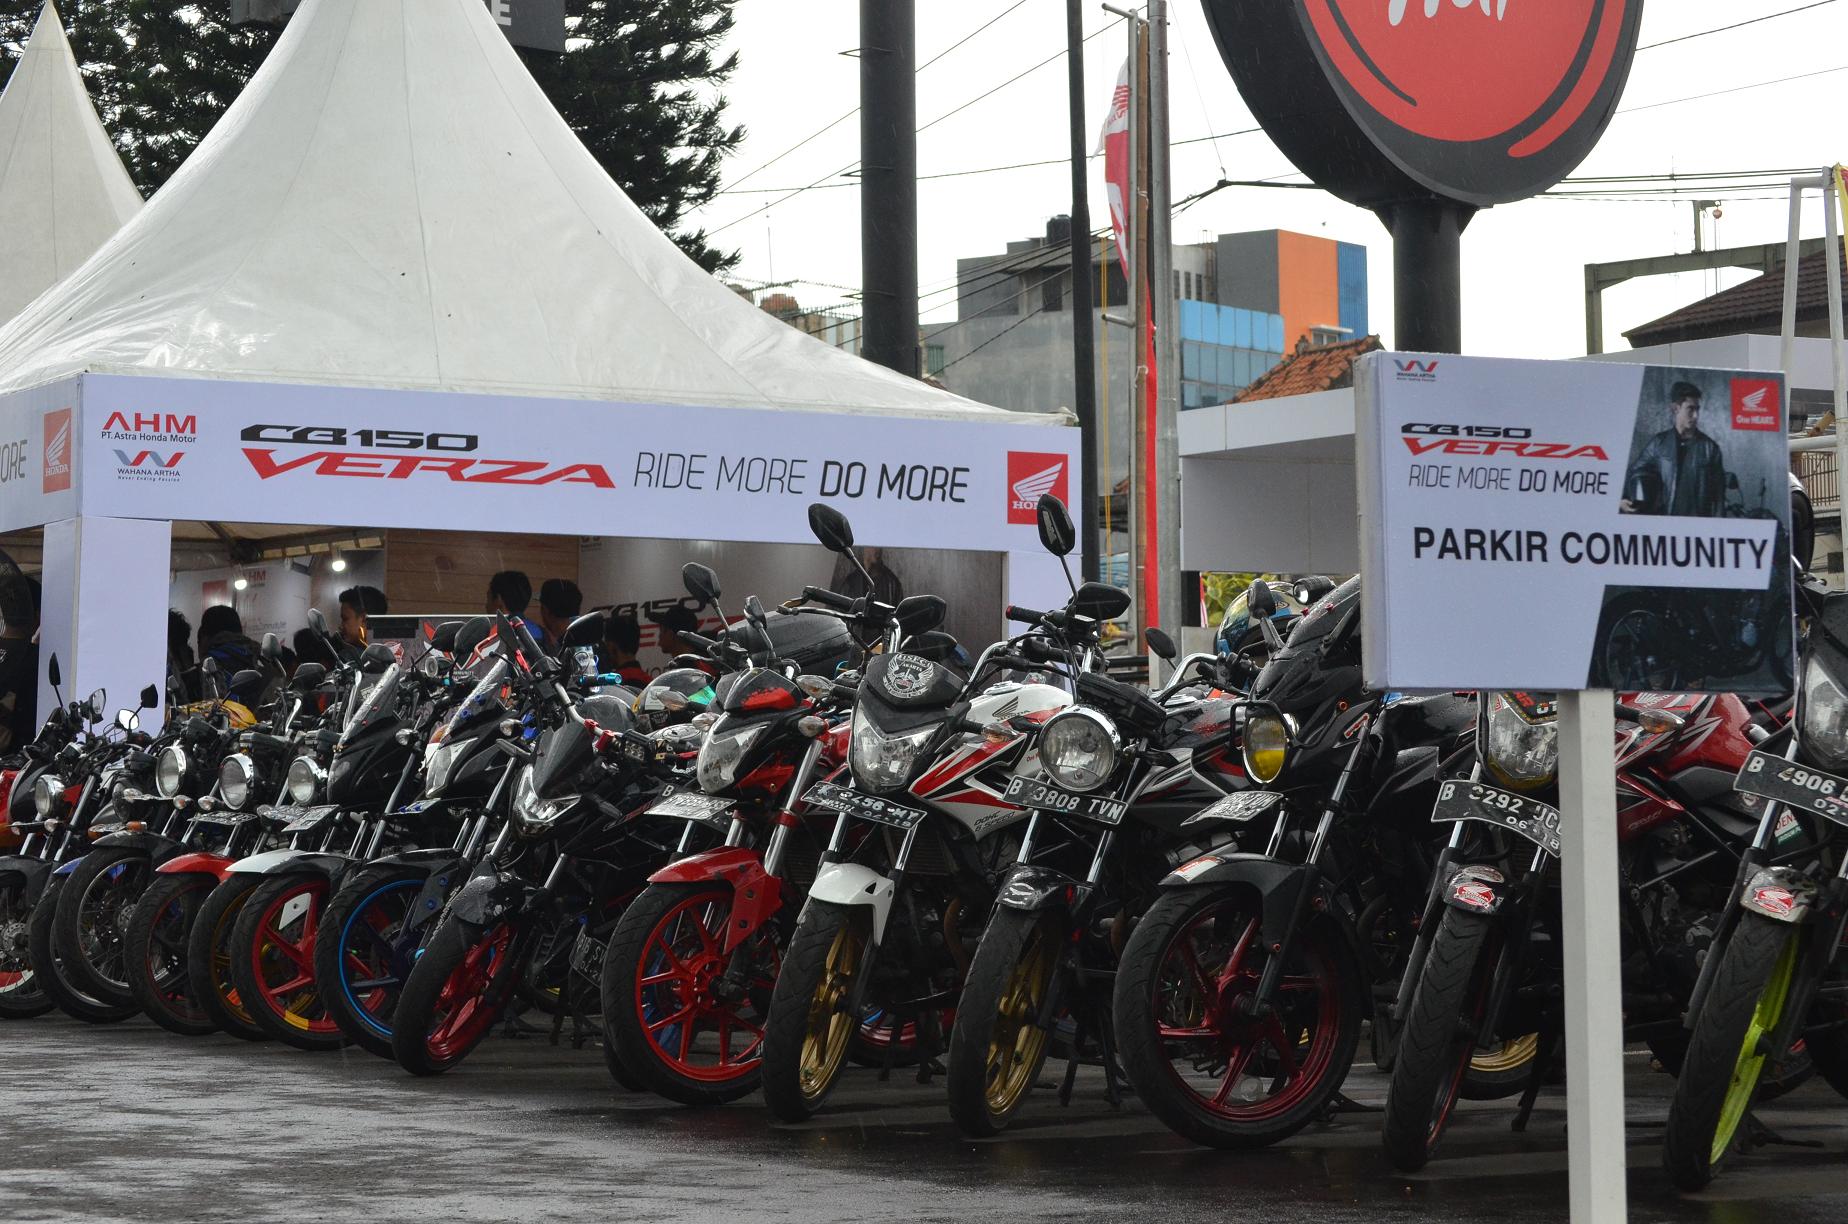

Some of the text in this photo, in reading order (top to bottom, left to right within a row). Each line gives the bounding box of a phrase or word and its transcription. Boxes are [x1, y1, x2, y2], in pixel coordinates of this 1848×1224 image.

[102, 411, 196, 434] AHM
[1401, 423, 1532, 439] CB150
[101, 431, 197, 443] PT. Astra Honda Motor
[241, 424, 478, 451] CB150
[1402, 437, 1609, 461] VERZA
[0, 439, 28, 483] ORE
[117, 468, 180, 477] WAHANA ARTHA
[241, 447, 616, 489] VERZA
[634, 452, 970, 503] RIDE MORE DO MORE
[1409, 464, 1609, 494] RIDE MORE DO MORE
[1414, 527, 1769, 569] PARKIR COMMUNITY
[1747, 756, 1765, 773] B
[1008, 779, 1123, 820] B 3808 TVN
[1441, 784, 1456, 800] B
